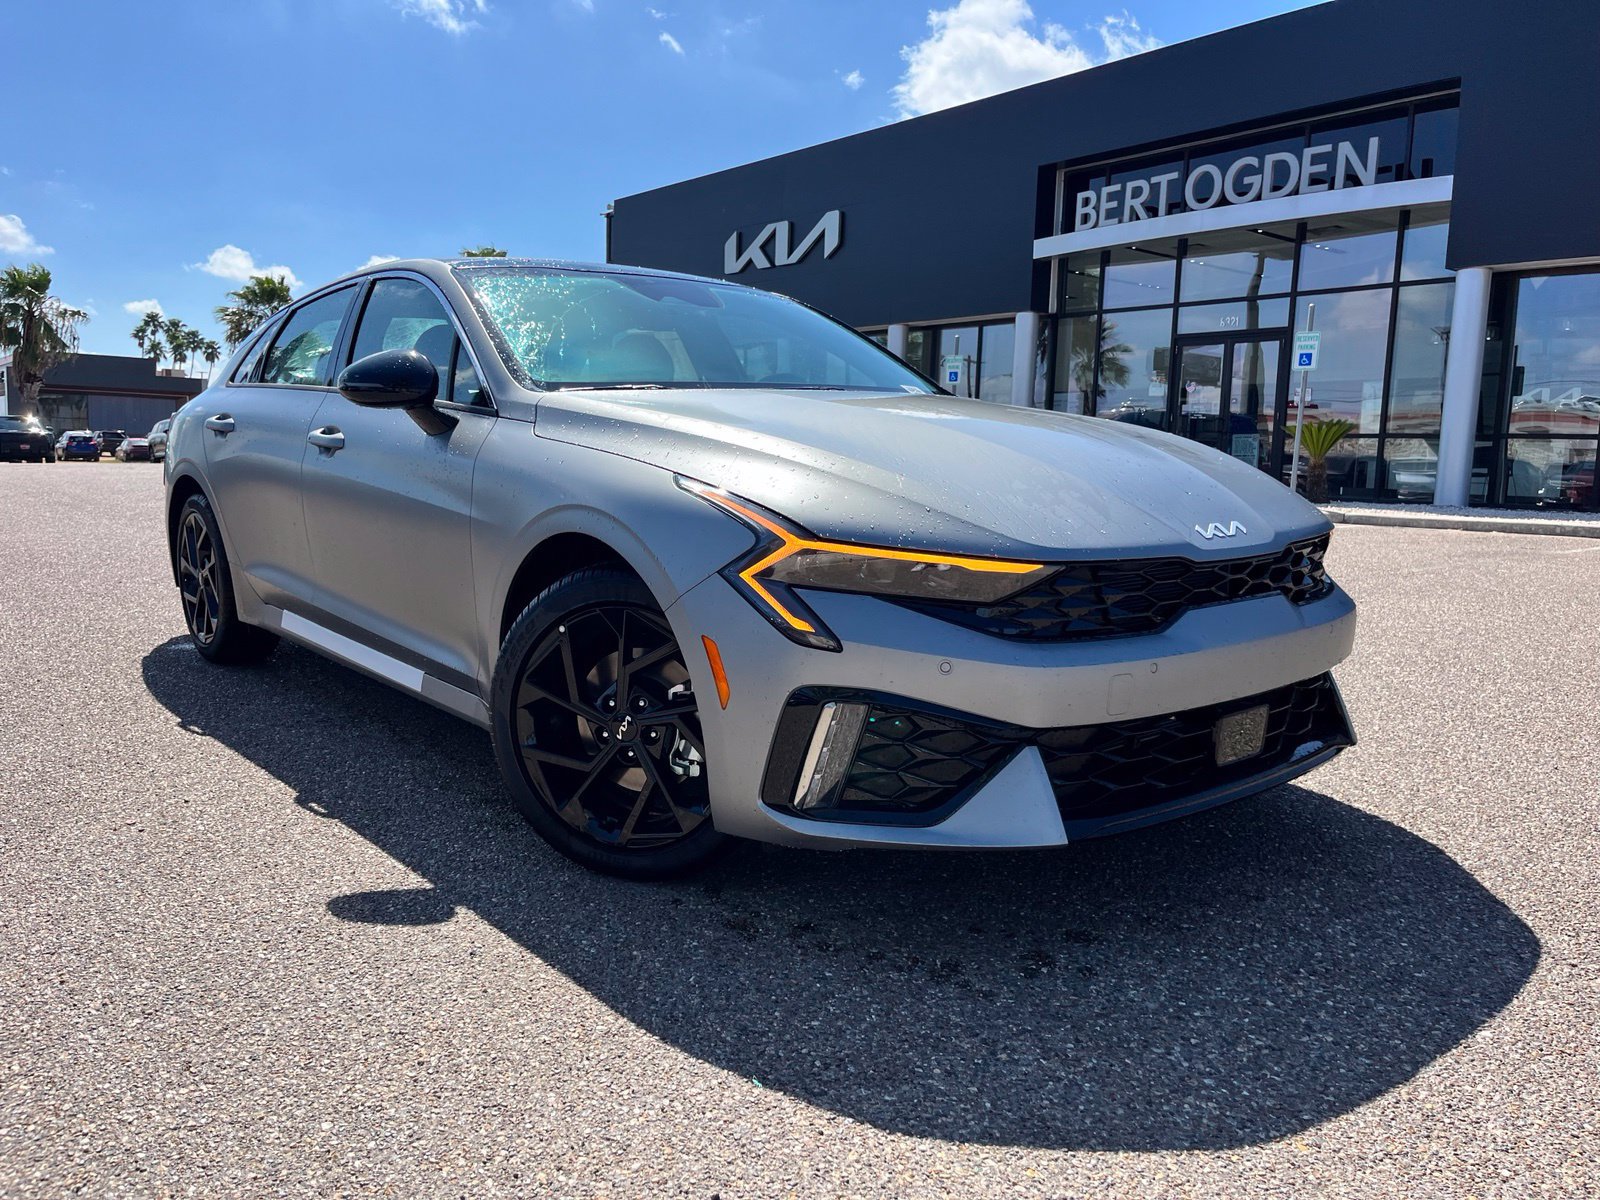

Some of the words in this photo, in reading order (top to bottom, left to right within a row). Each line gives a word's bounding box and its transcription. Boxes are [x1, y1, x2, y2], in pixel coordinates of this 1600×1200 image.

[1074, 171, 1179, 232] BERT
[1184, 136, 1379, 211] OGDEN
[724, 209, 840, 275] KIA
[1194, 521, 1247, 539] KIA
